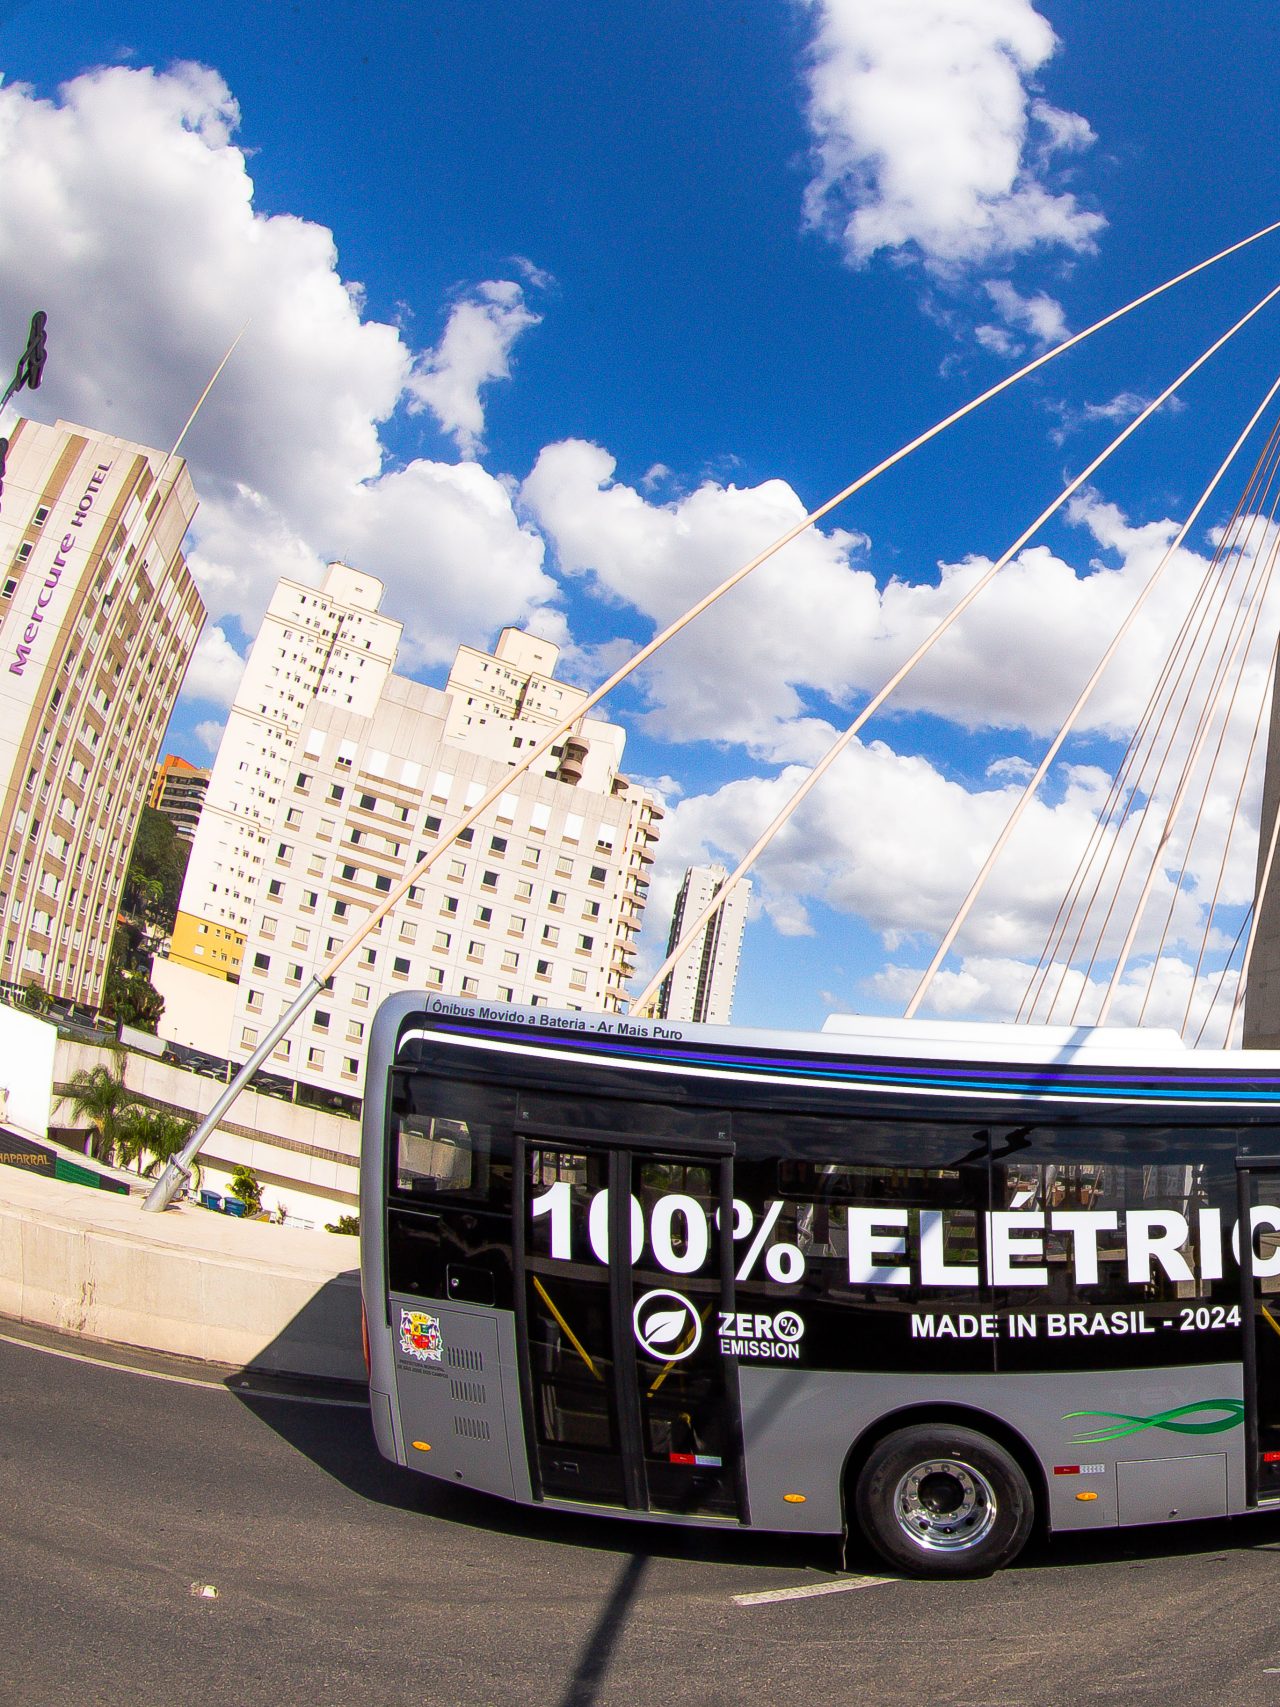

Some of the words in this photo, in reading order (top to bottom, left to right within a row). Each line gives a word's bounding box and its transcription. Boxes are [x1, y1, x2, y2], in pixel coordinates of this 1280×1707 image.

[8, 533, 77, 677] Mercure
[71, 460, 113, 528] HOTEL
[432, 1001, 475, 1017] Ônibus
[479, 1007, 525, 1024] Movido
[528, 1015, 536, 1025] a
[539, 1014, 586, 1030] Bateria
[597, 1020, 614, 1033] Ar
[617, 1022, 649, 1037] Mais
[653, 1026, 683, 1041] Puro
[532, 1181, 805, 1284] 100%
[911, 1313, 999, 1338] MADE
[1008, 1314, 1038, 1338] IN
[1047, 1310, 1155, 1337] BRASIL
[1179, 1305, 1242, 1331] 2024
[720, 1338, 800, 1359] EMISSION
